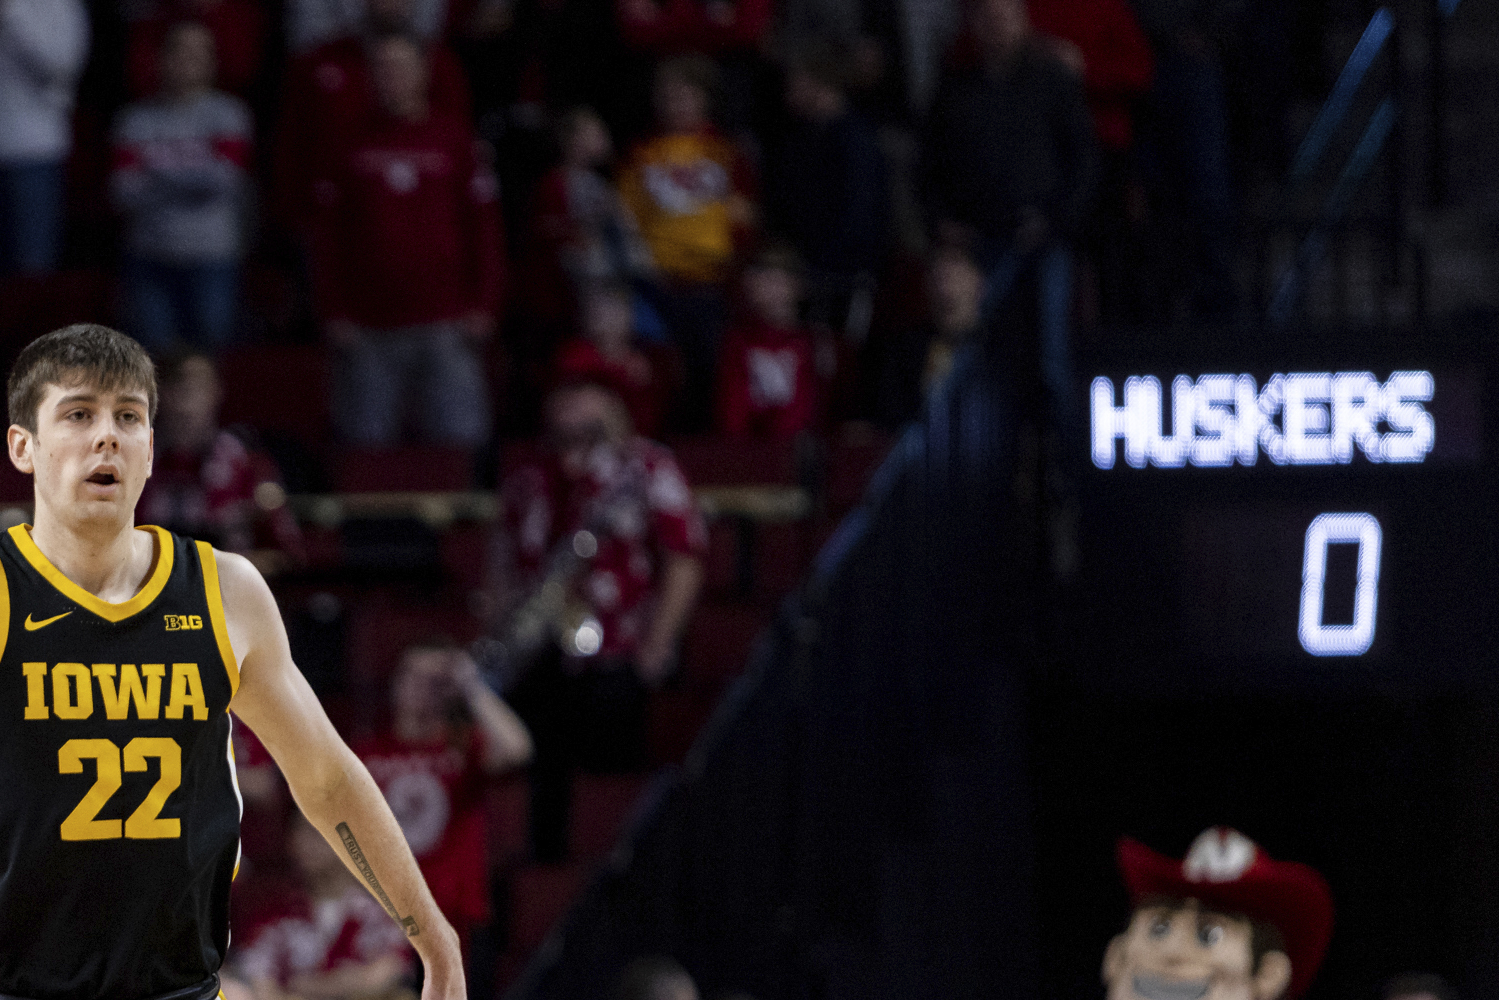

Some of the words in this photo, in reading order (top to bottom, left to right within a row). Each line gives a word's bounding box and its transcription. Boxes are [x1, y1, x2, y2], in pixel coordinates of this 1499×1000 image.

[1091, 371, 1434, 469] HUSKERS
[1299, 513, 1381, 656] 0
[22, 662, 209, 720] IOWA
[58, 737, 182, 841] 22
[344, 834, 366, 866] TRUST
